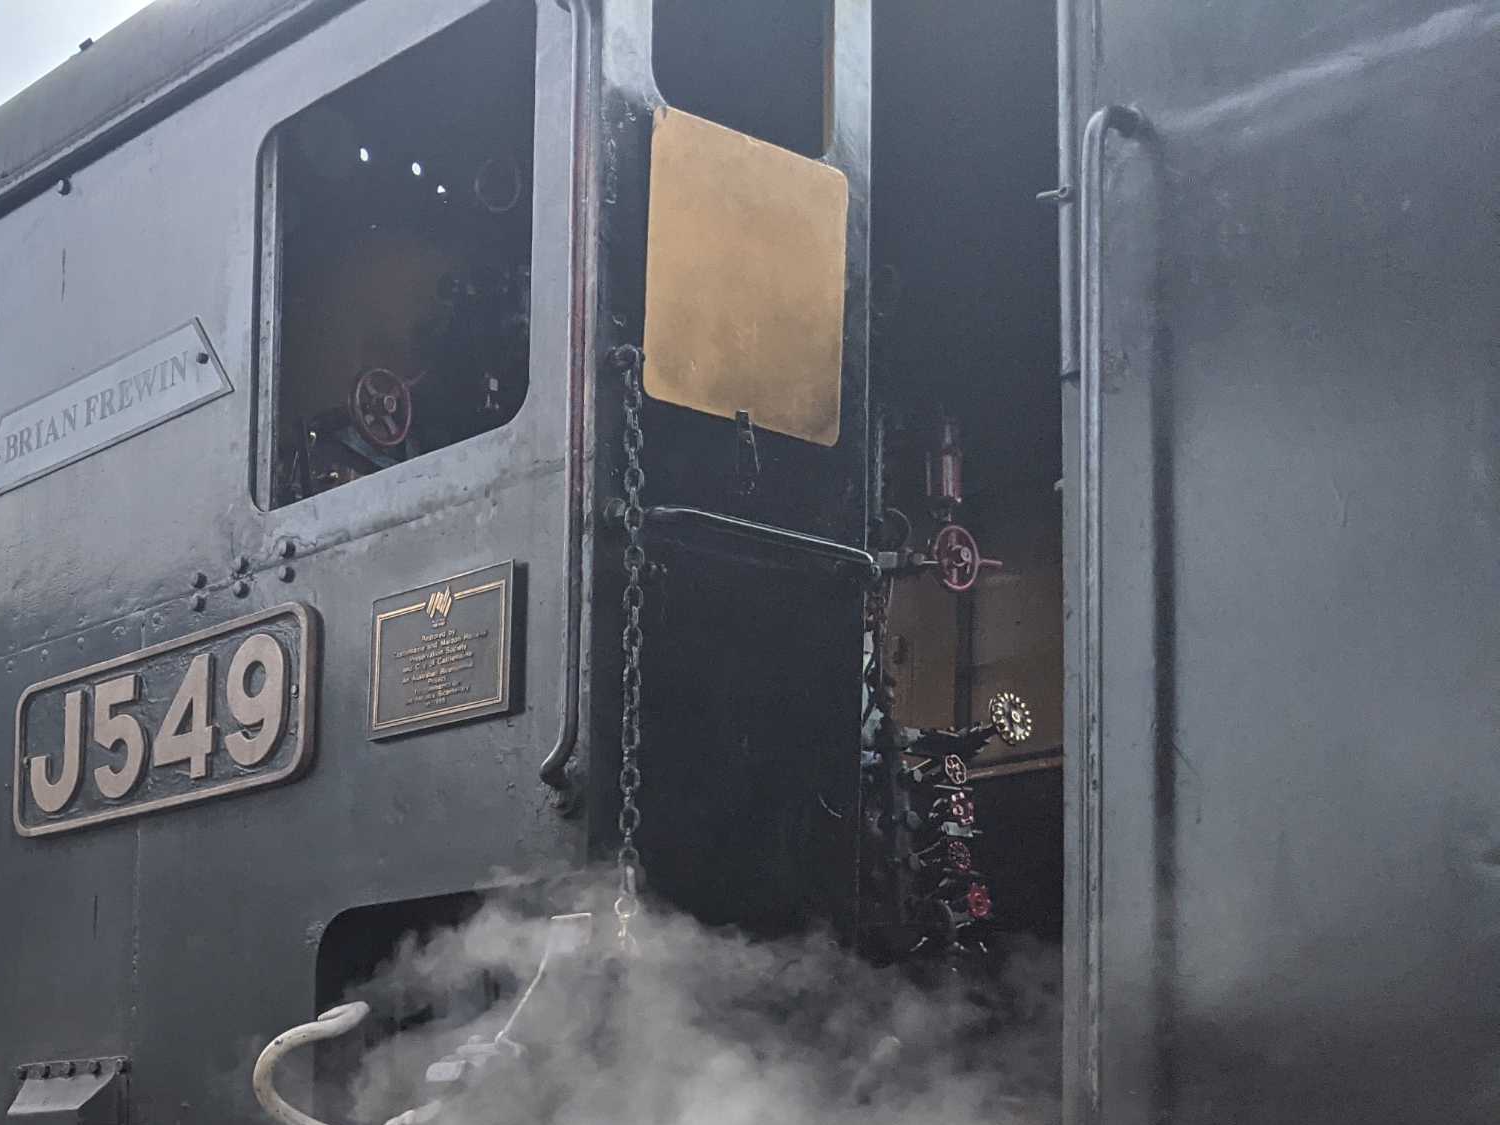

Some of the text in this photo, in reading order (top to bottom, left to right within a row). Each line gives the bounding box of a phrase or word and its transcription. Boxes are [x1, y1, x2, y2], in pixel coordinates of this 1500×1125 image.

[3, 351, 188, 464] BRIAN FREWIN
[30, 633, 285, 813] J549
